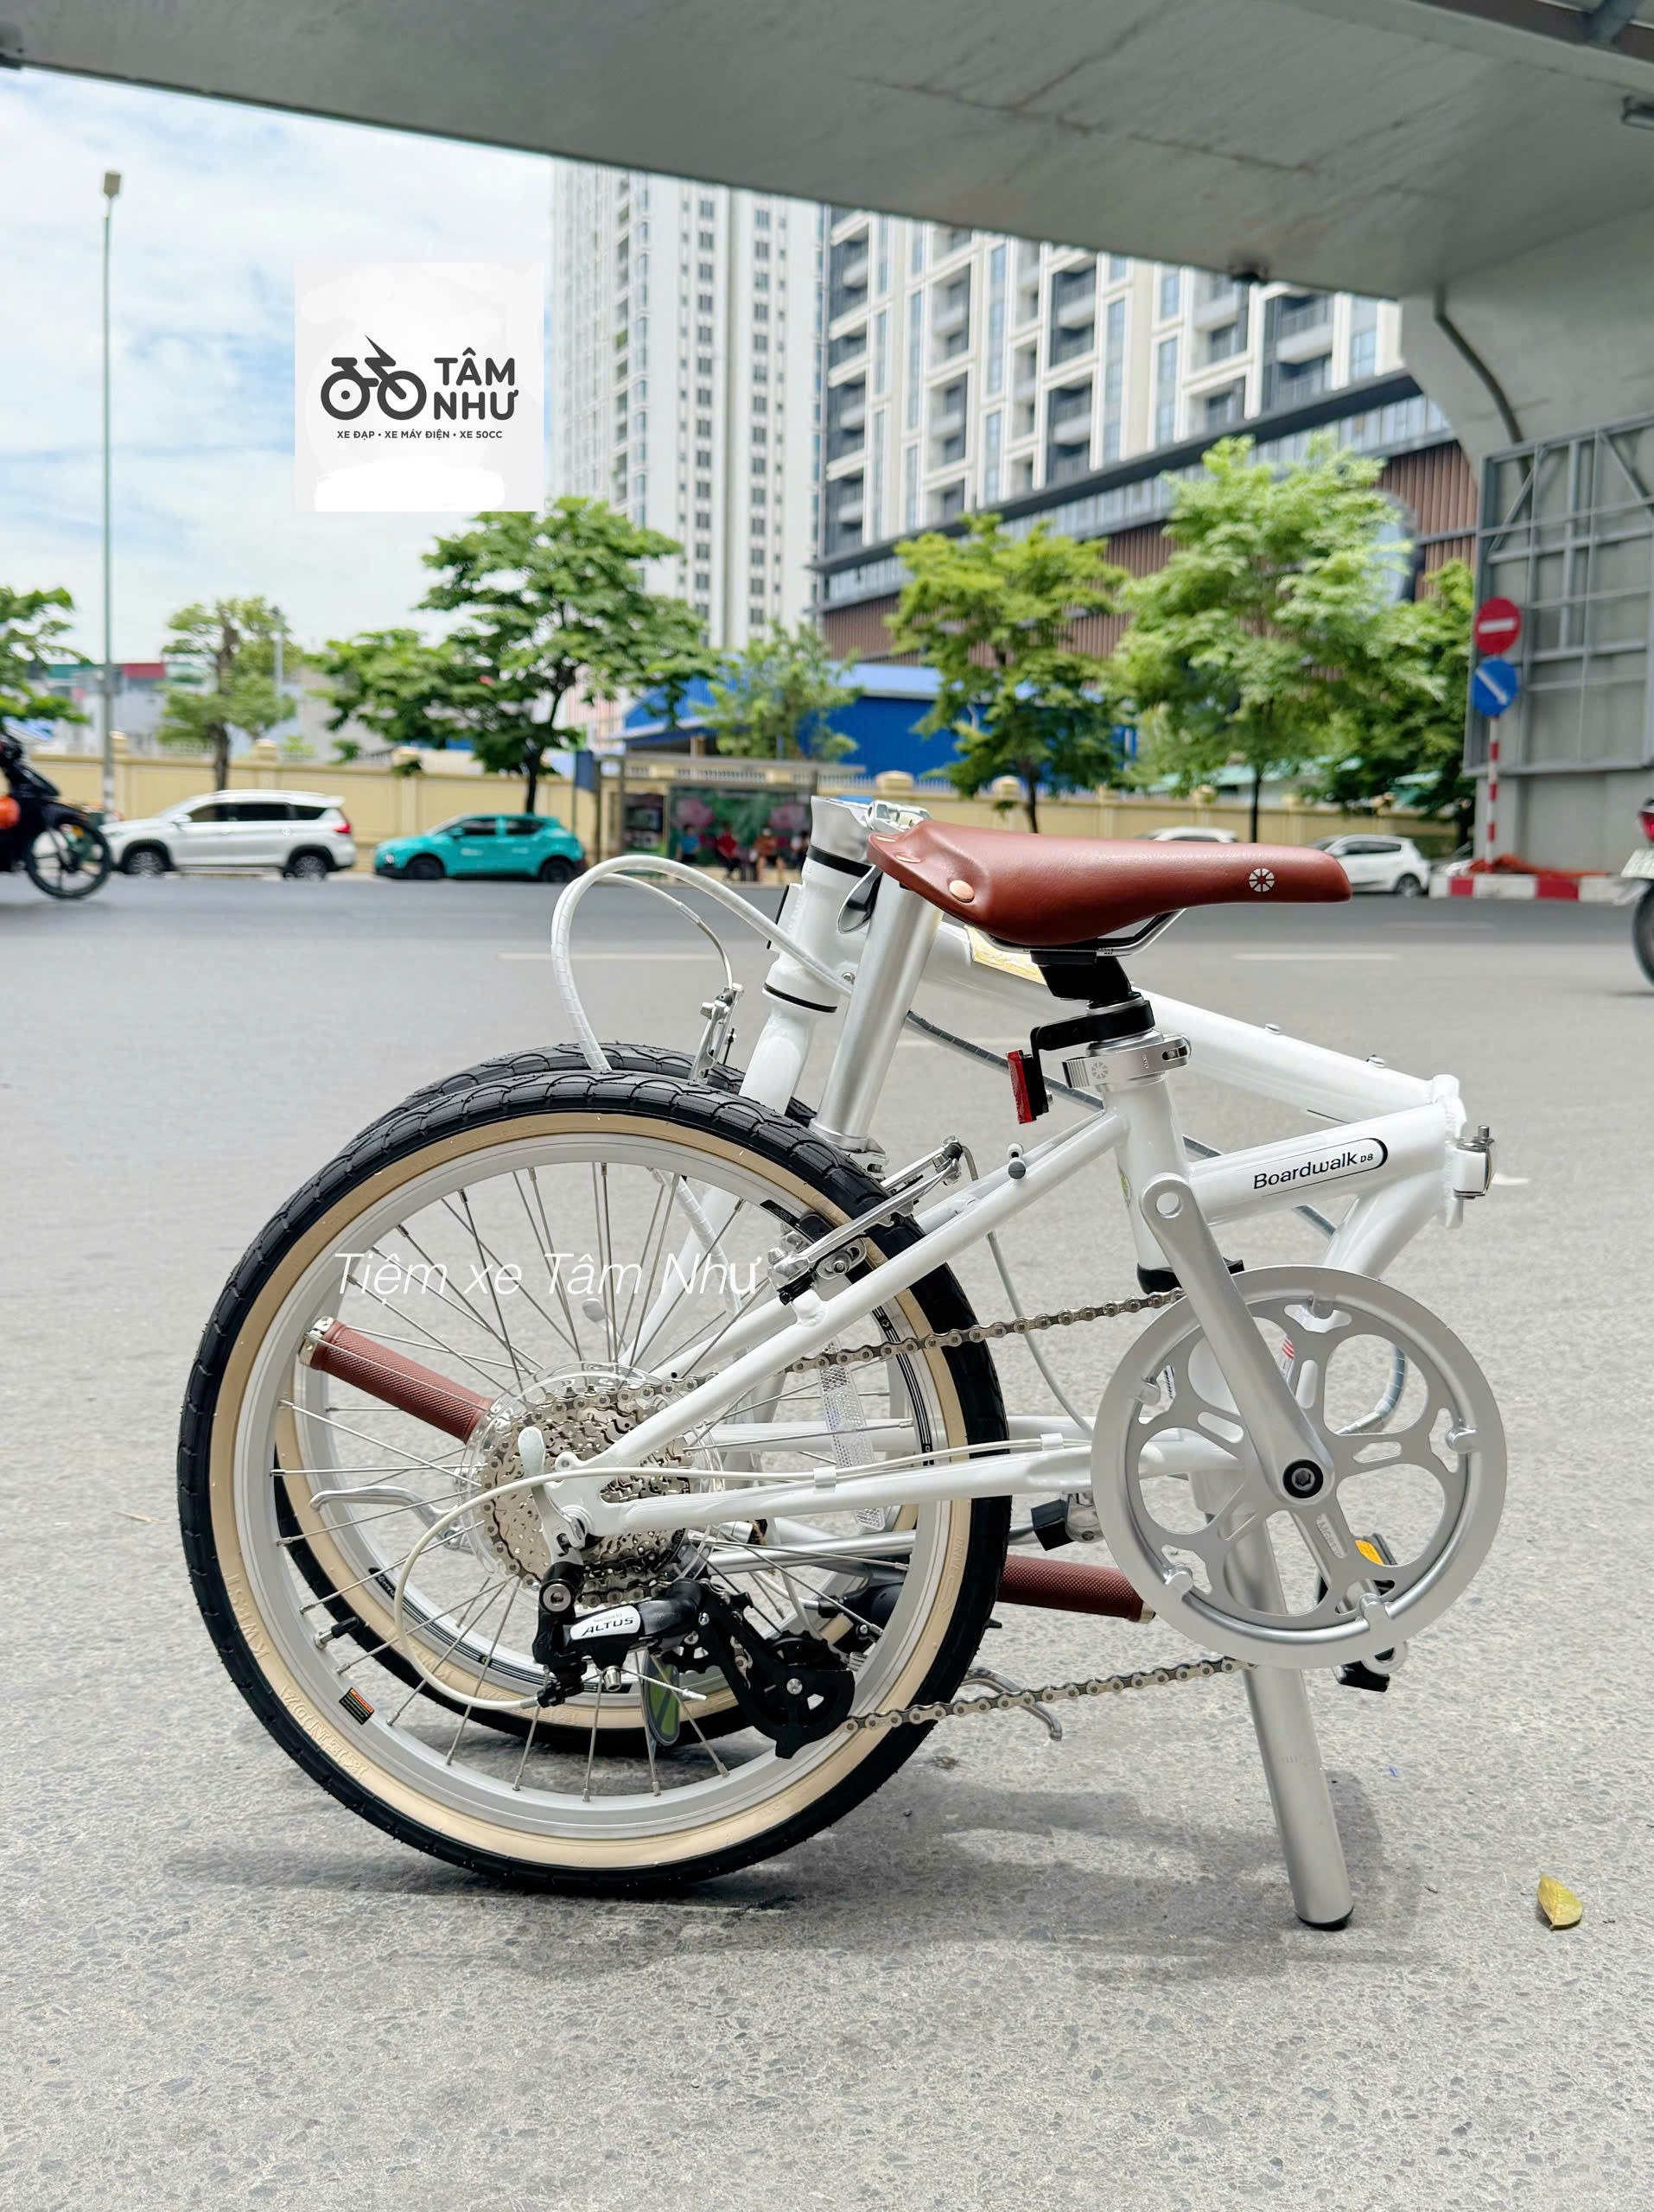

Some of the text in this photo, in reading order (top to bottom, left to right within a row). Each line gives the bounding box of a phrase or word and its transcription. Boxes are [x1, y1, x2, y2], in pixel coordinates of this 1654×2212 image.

[1253, 1152, 1373, 1190] Boardwalk D8
[582, 1618, 634, 1636] ALTUS
[278, 1685, 370, 1781] KENDA
